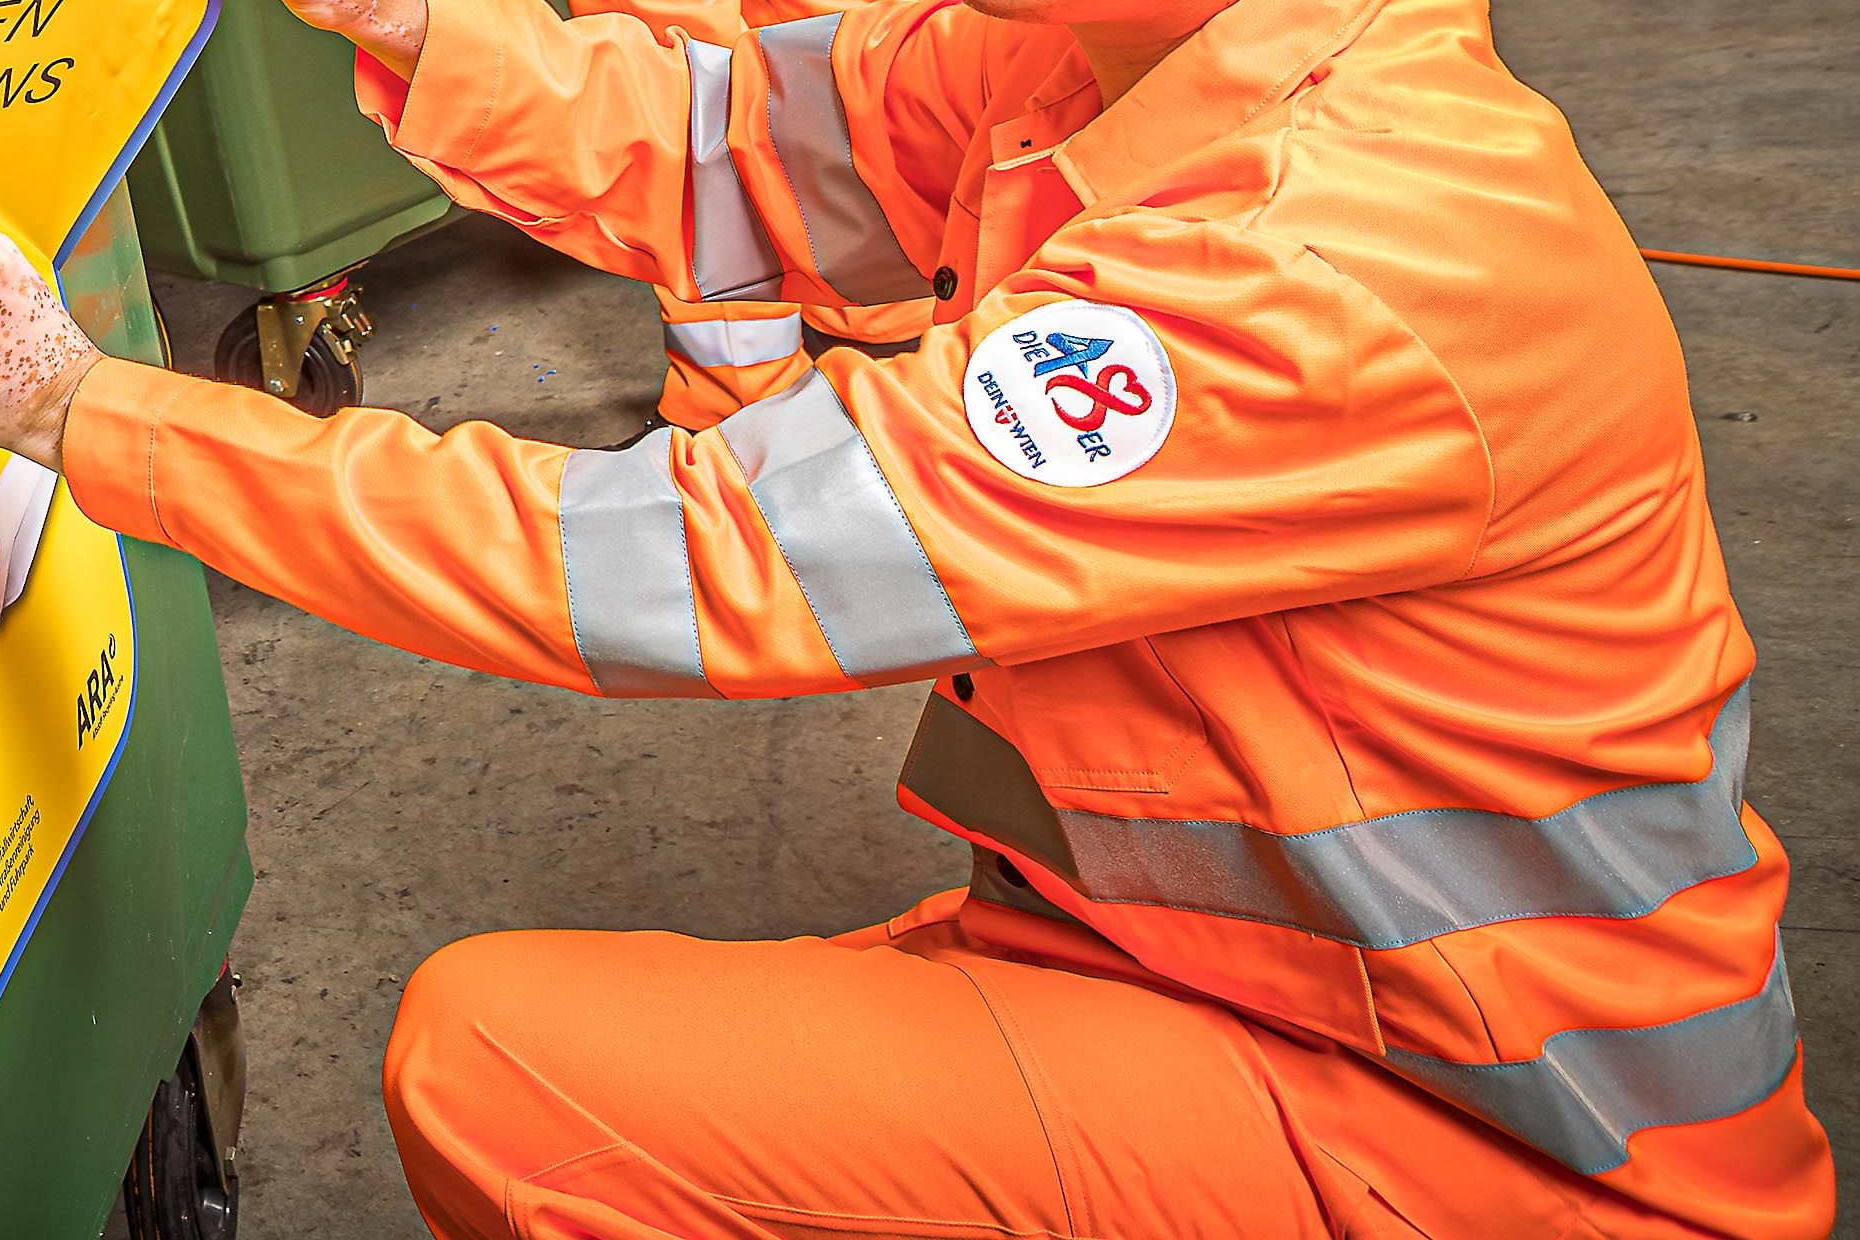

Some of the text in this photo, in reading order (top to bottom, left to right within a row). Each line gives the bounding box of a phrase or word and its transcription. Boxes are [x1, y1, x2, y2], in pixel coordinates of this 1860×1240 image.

[1012, 330, 1050, 362] DIE
[977, 370, 1046, 469] DEIN WIEN
[77, 649, 115, 750] ARA
[0, 843, 35, 912] und Fuhrpark
